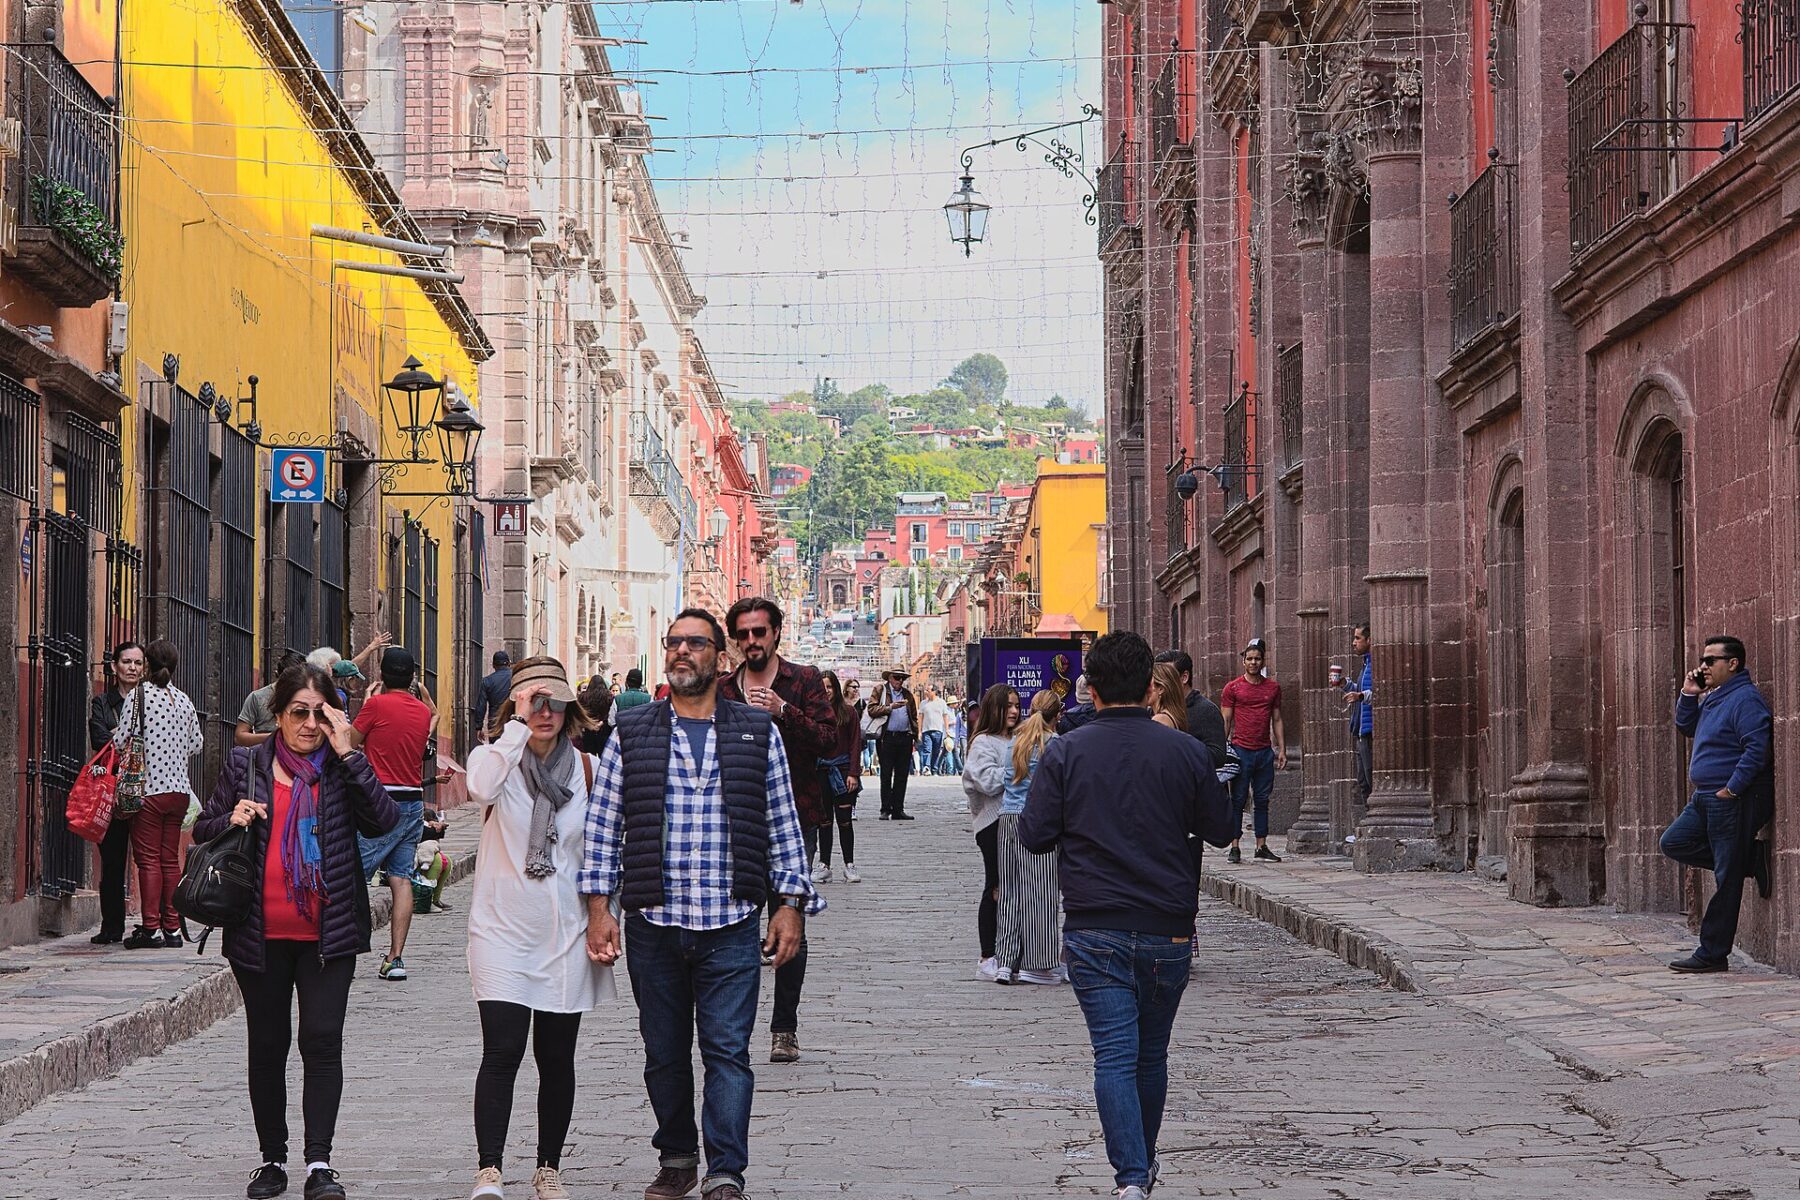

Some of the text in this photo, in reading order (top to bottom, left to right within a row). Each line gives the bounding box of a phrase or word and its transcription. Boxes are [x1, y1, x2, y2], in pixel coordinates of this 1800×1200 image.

[291, 460, 305, 480] E
[1019, 656, 1029, 664] XLI
[1007, 670, 1042, 678] LA LANA Y
[1007, 678, 1042, 687] EL LATÓN
